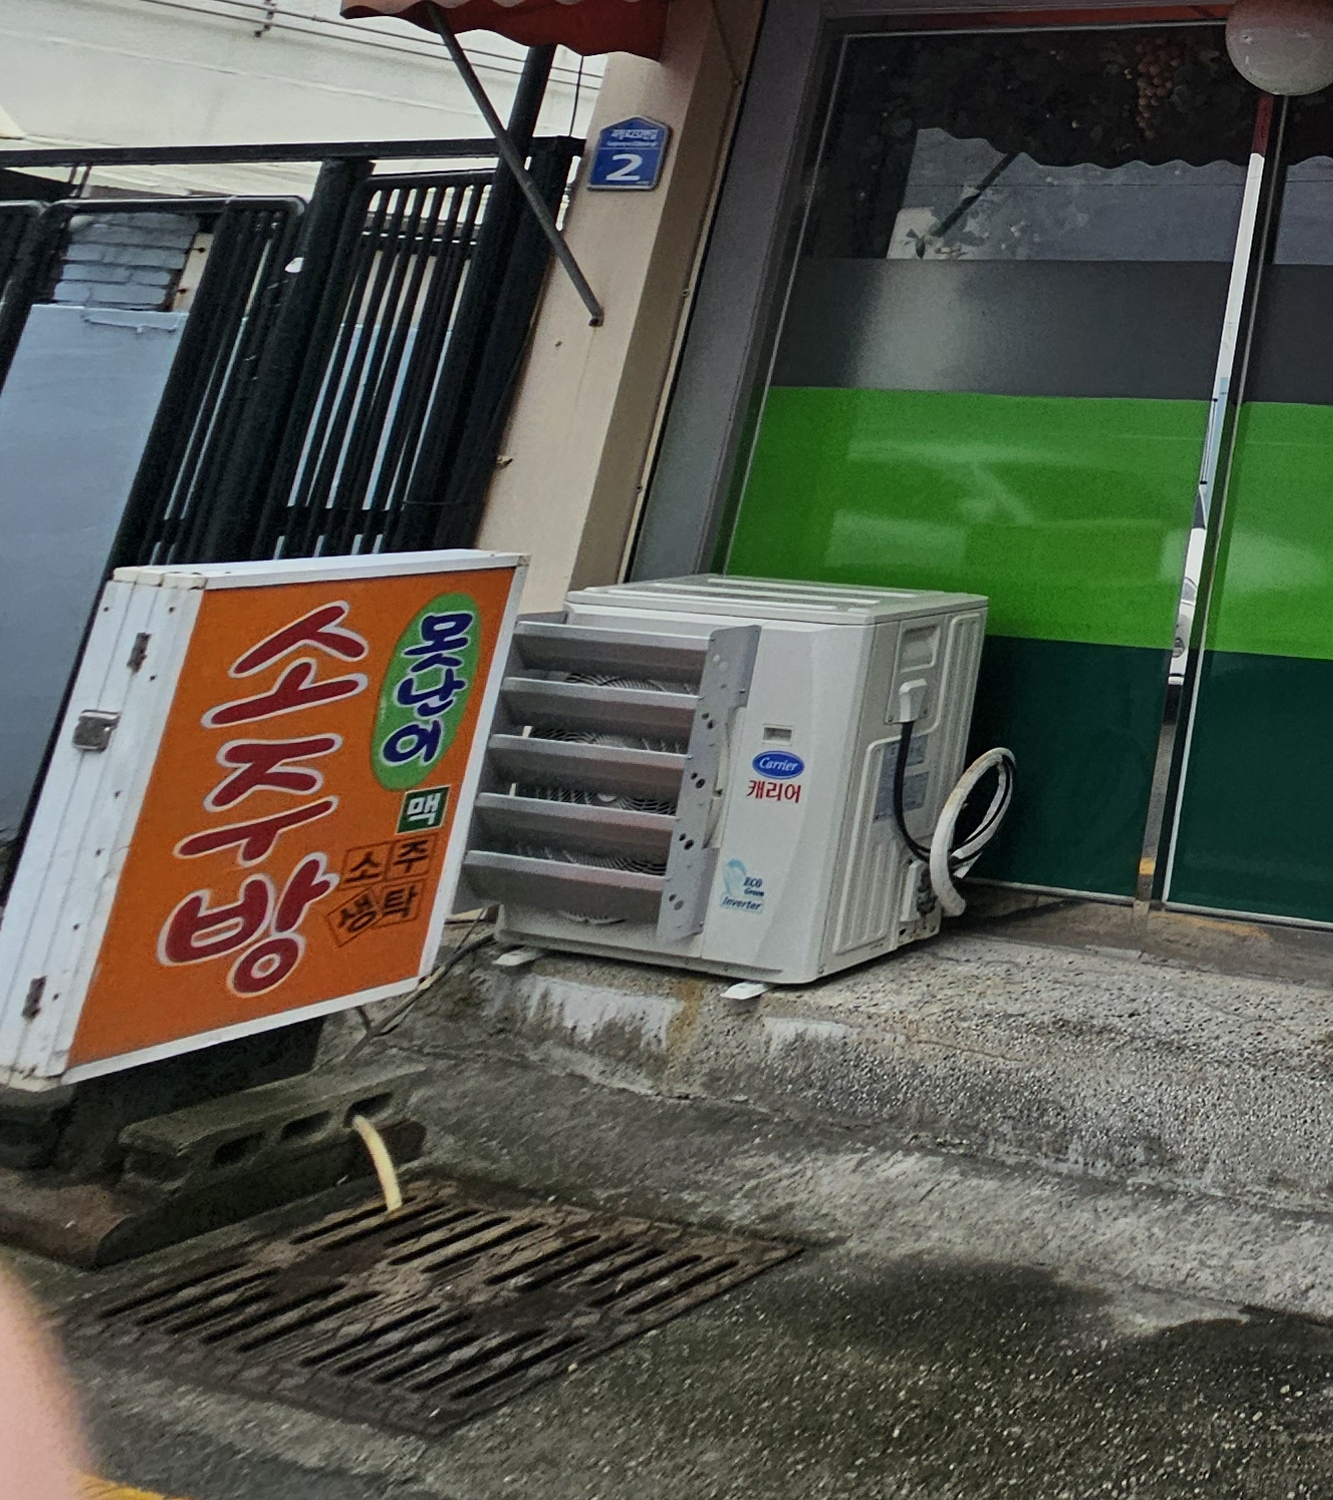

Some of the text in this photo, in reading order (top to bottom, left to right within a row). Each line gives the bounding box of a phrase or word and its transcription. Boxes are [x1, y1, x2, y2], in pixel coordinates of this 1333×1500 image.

[605, 153, 643, 181] 2
[381, 611, 474, 766] 못난이
[759, 756, 799, 772] Carrier
[160, 602, 367, 996] 소주방
[406, 791, 440, 825] 맥
[747, 780, 801, 803] 캐리어
[346, 839, 428, 884] 소주
[338, 885, 418, 934] 생탁
[722, 896, 762, 911] Inverter
